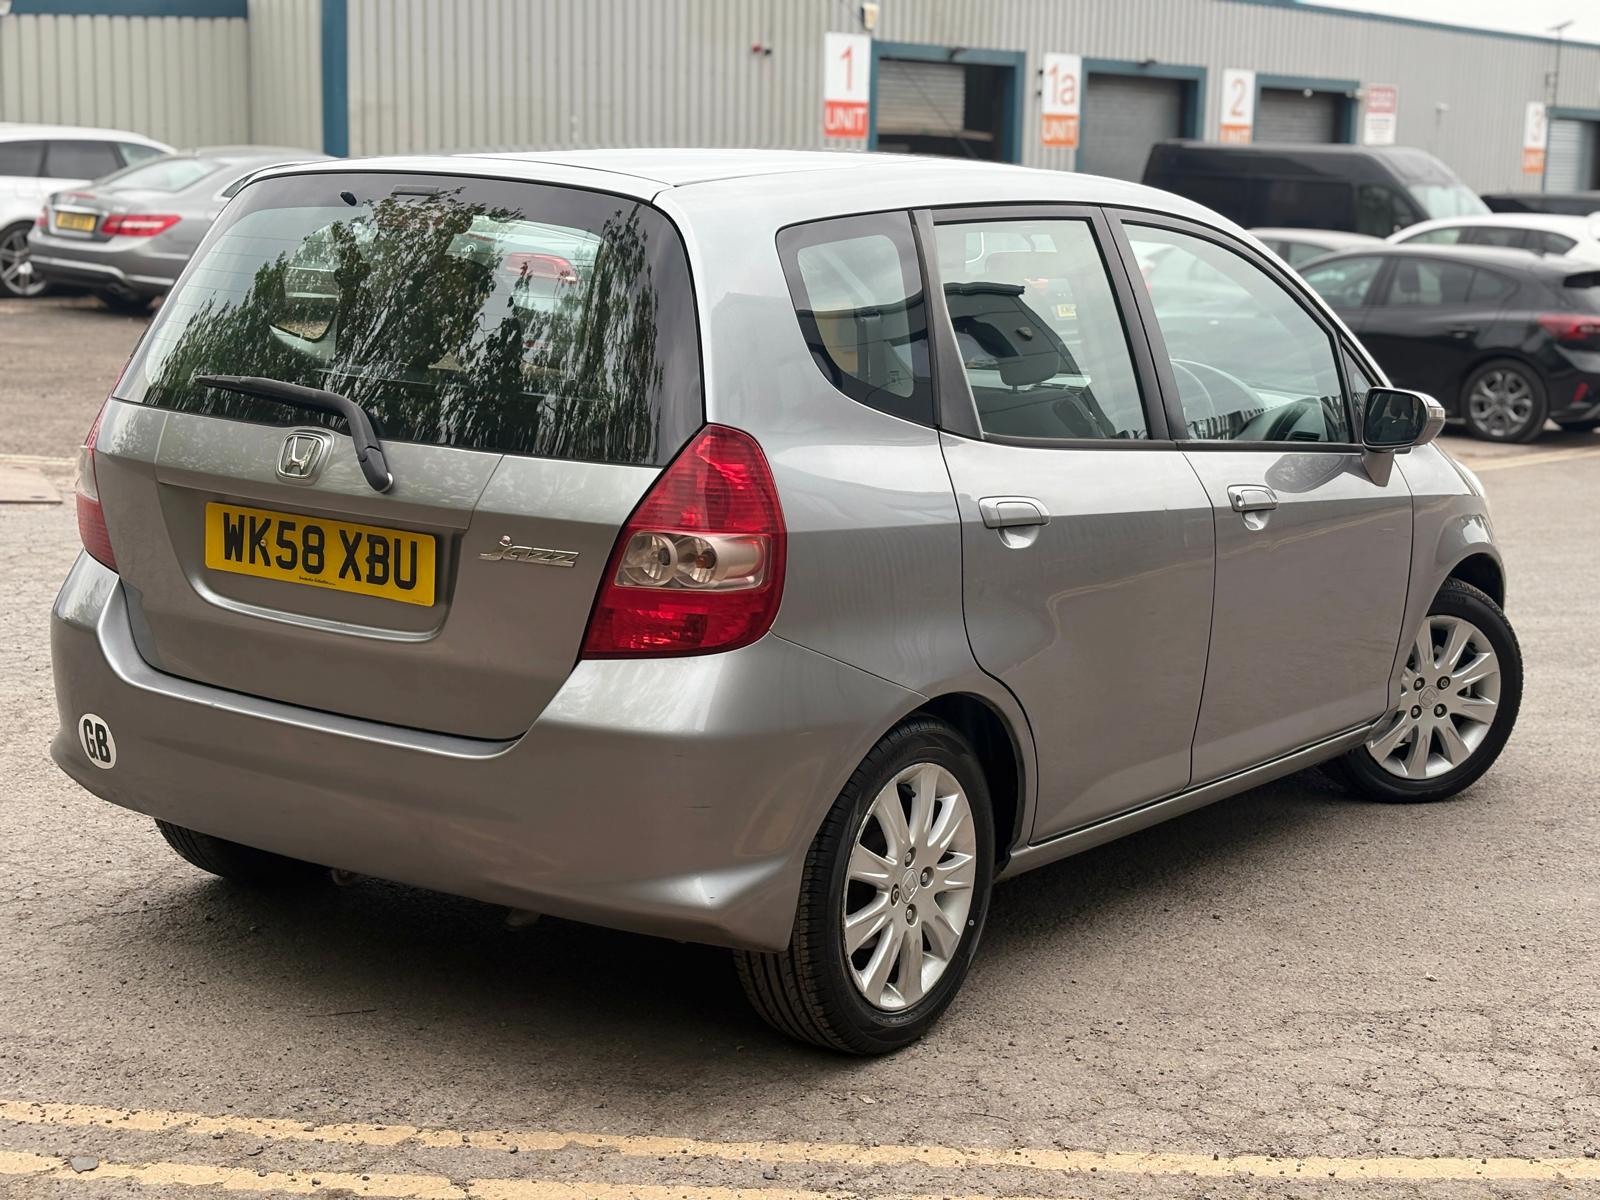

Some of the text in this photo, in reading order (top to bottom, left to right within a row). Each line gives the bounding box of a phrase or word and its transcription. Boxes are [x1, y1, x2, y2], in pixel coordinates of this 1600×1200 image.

[840, 45, 853, 91] 1
[1048, 64, 1076, 105] 1a
[1230, 79, 1246, 116] 2
[825, 107, 866, 130] UNIT
[1042, 120, 1078, 139] UNIT
[223, 512, 418, 591] WK58 XBU
[83, 718, 111, 763] GB
